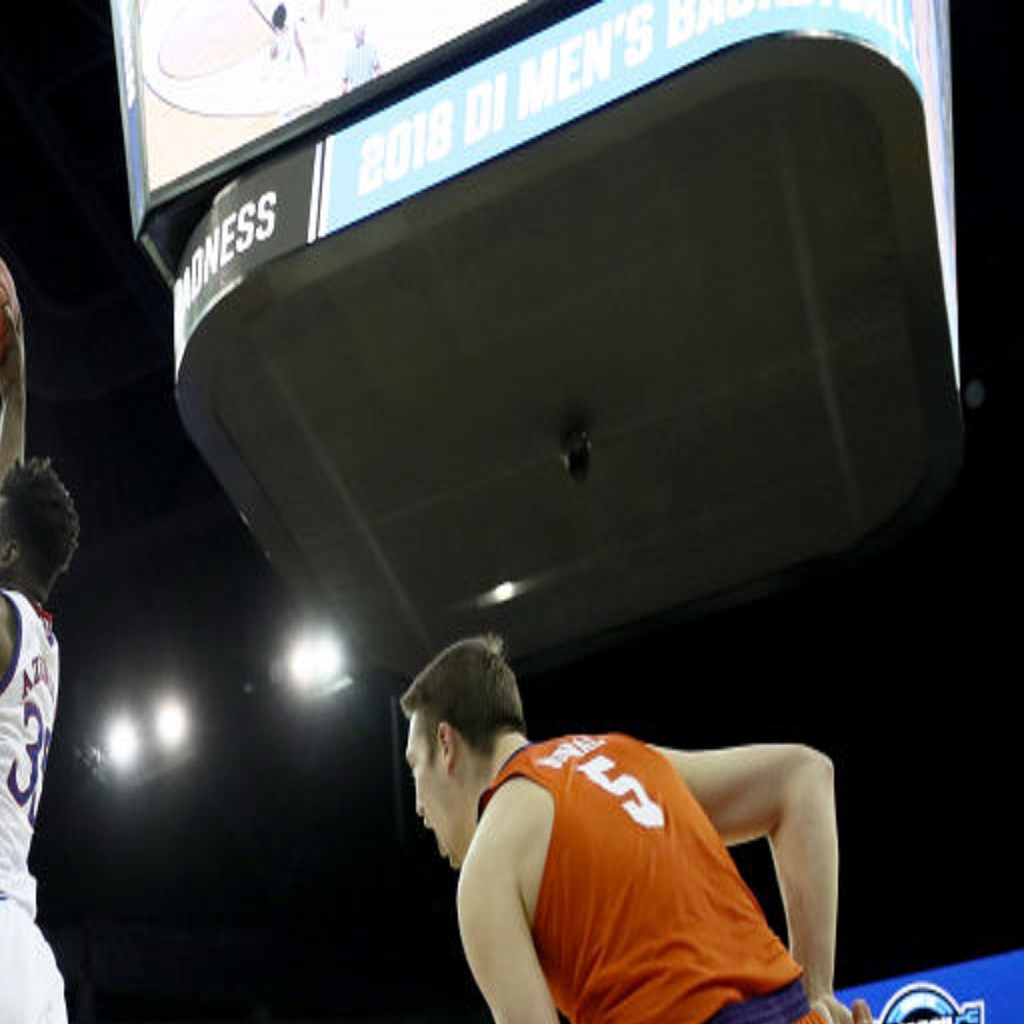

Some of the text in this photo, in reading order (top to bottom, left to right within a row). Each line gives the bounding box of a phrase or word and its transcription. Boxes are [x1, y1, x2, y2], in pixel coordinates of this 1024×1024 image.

[356, 99, 454, 196] 2018
[464, 72, 507, 146] DI
[517, 3, 654, 121] MEN'S
[577, 755, 666, 829] 5
